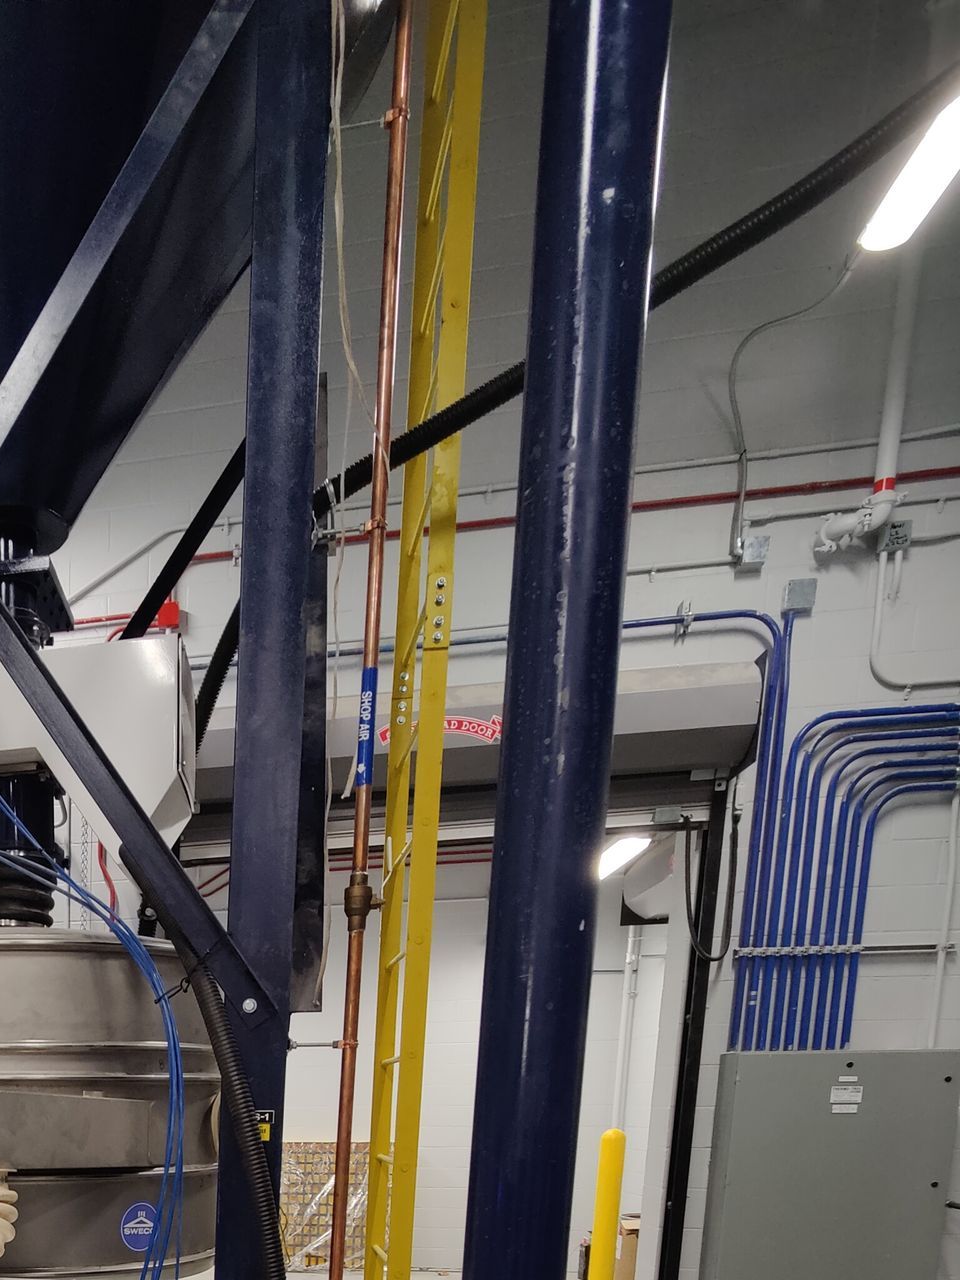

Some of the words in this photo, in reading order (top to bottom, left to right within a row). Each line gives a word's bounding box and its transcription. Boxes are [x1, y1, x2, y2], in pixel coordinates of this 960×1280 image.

[360, 691, 373, 720] SHOP
[358, 724, 370, 741] AIR
[462, 722, 493, 739] DOOR
